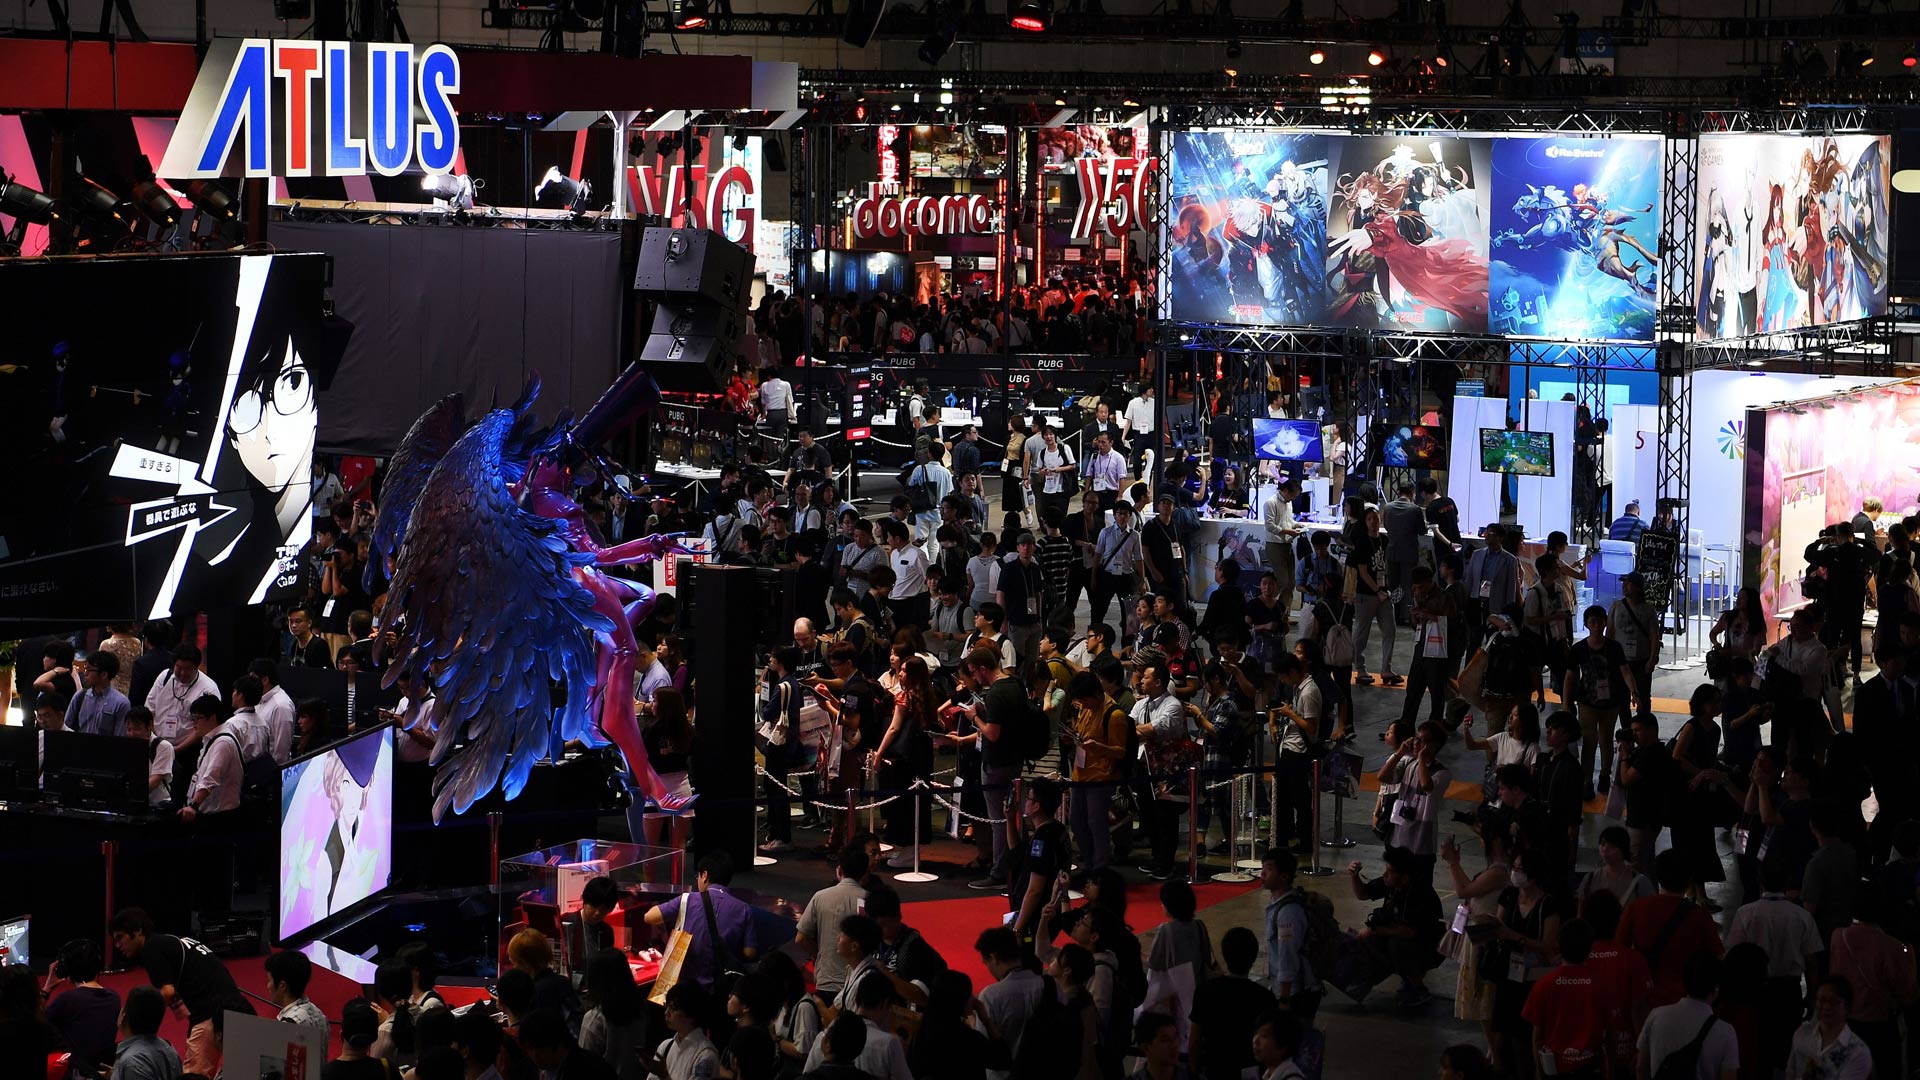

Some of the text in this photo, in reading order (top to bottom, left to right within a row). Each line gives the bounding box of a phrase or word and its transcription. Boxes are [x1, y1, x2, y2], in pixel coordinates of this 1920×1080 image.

[194, 38, 461, 178] ATLUS
[853, 181, 990, 239] docomo
[890, 357, 916, 366] PUBG
[1037, 359, 1064, 368] PUBG
[1008, 374, 1031, 384] UBG
[667, 410, 685, 421] PUBG
[1555, 976, 1592, 985] docomo
